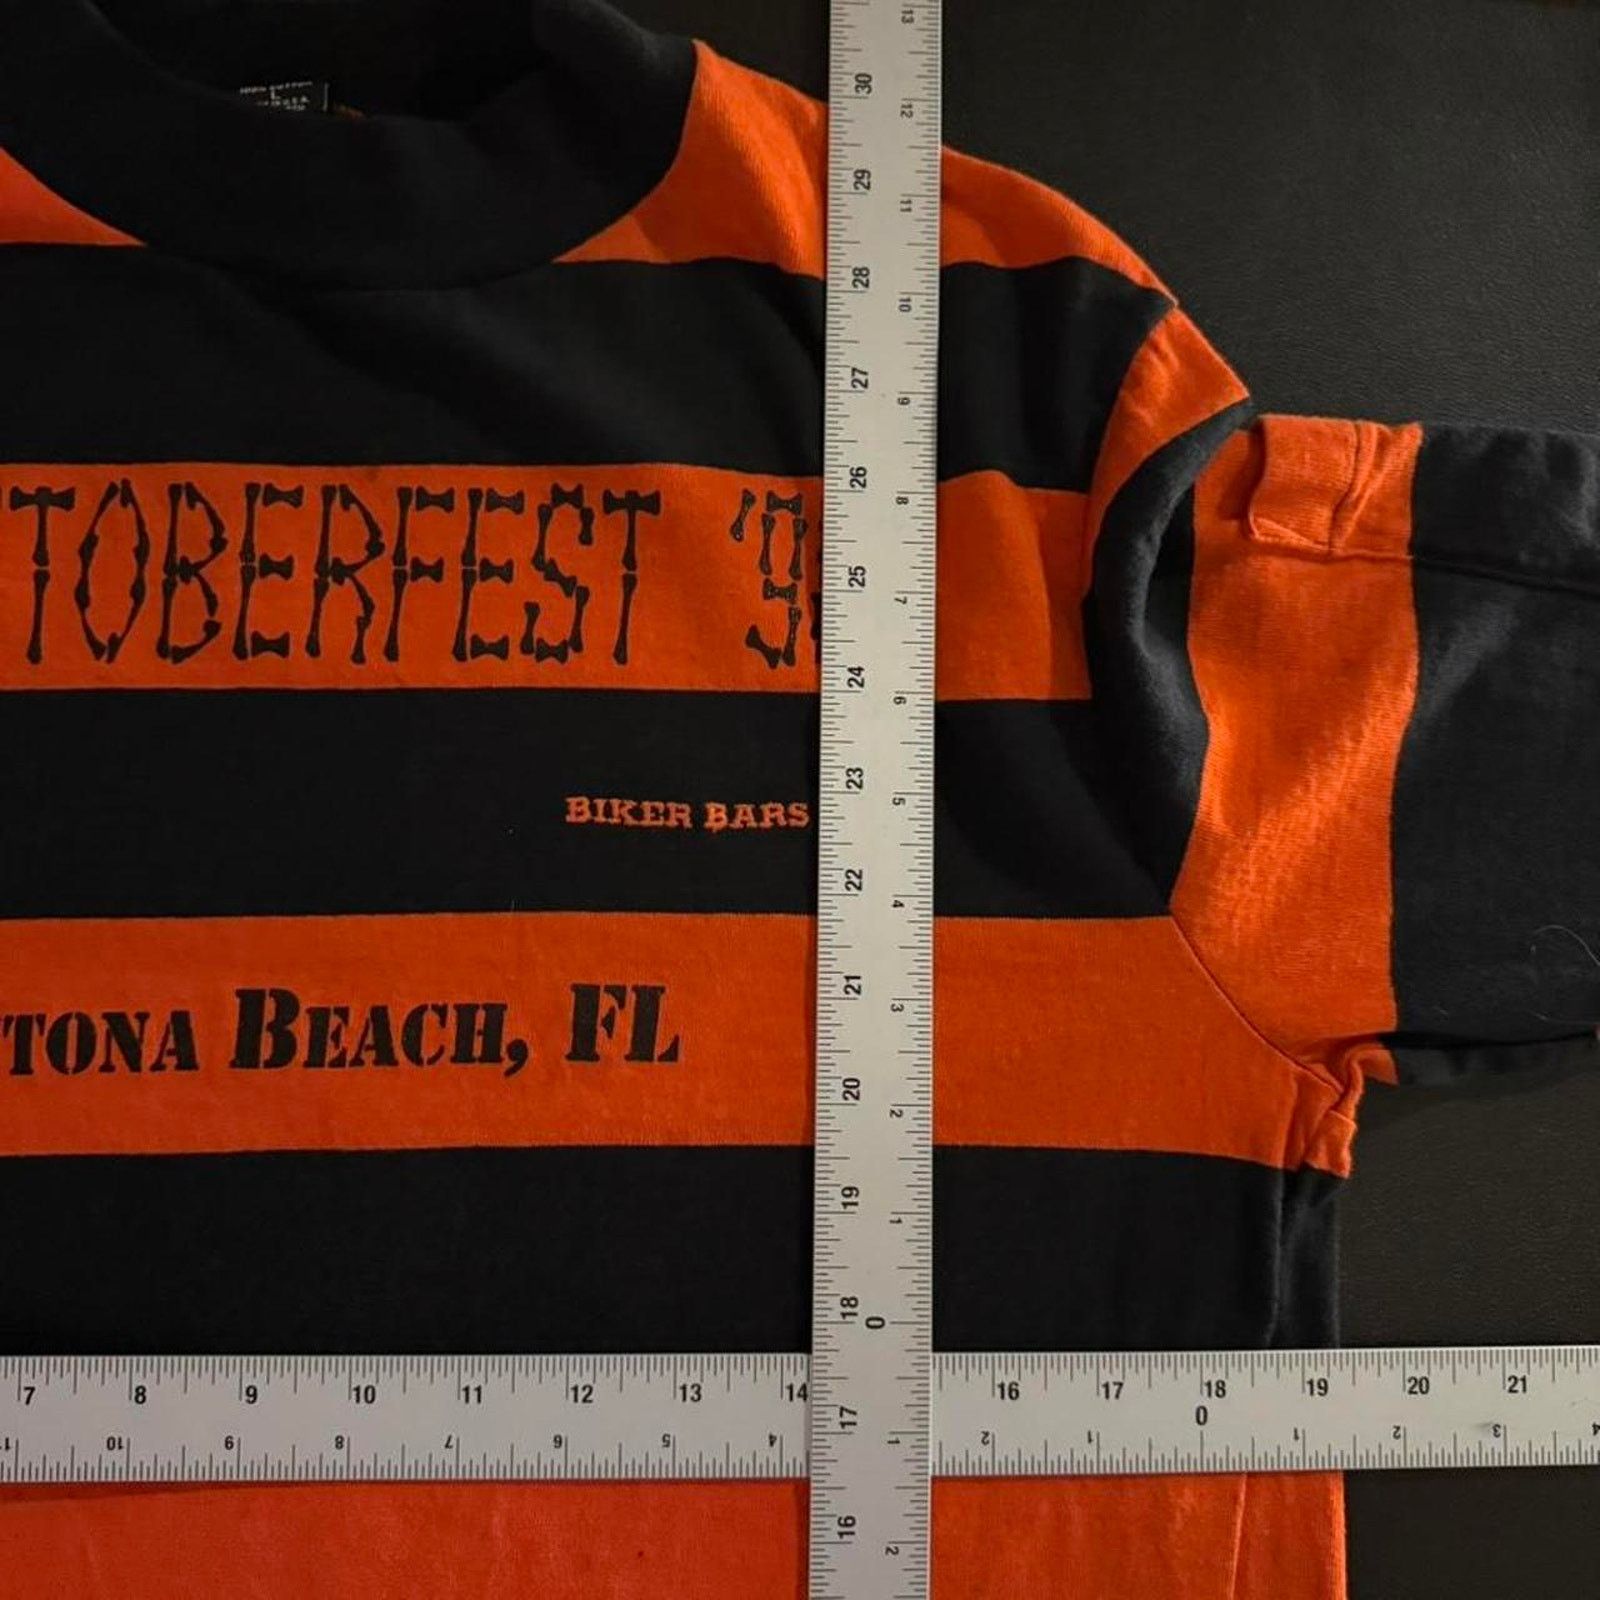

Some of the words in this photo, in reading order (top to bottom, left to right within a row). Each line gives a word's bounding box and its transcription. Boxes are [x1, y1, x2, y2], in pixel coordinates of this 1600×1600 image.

[901, 9, 914, 24] 13
[855, 73, 872, 94] 30
[901, 103, 913, 118] 12
[854, 169, 871, 190] 29
[900, 199, 911, 213] 11
[852, 267, 870, 288] 28
[899, 297, 911, 312] 10
[851, 367, 868, 389] 27
[850, 466, 867, 488] 26
[0, 478, 662, 666] TOBERFEST
[730, 490, 823, 668] '9
[848, 565, 865, 587] 25
[848, 666, 864, 688] 24
[846, 767, 863, 789] 23
[565, 795, 693, 829] BIKER
[703, 801, 810, 832] BARS
[845, 869, 862, 891] 22
[844, 974, 861, 995] 21
[2, 1010, 200, 1075] TONA
[565, 983, 680, 1063] FL
[842, 1077, 860, 1100] 20
[841, 1186, 859, 1209] 19
[840, 1296, 858, 1319] 18
[24, 1386, 36, 1405] 7
[134, 1385, 147, 1405] 8
[245, 1385, 258, 1405] 9
[353, 1385, 376, 1404] 10
[461, 1385, 482, 1404] 11
[570, 1385, 593, 1404] 12
[679, 1384, 702, 1402] 13
[786, 1383, 809, 1402] 14
[996, 1382, 1020, 1400] 16
[1102, 1382, 1124, 1400] 17
[1204, 1380, 1226, 1398] 18
[1306, 1378, 1328, 1397] 19
[1407, 1377, 1430, 1395] 20
[1508, 1375, 1527, 1394] 21
[839, 1405, 857, 1429] 17
[106, 1436, 123, 1451] 10
[837, 1515, 856, 1539] 16
